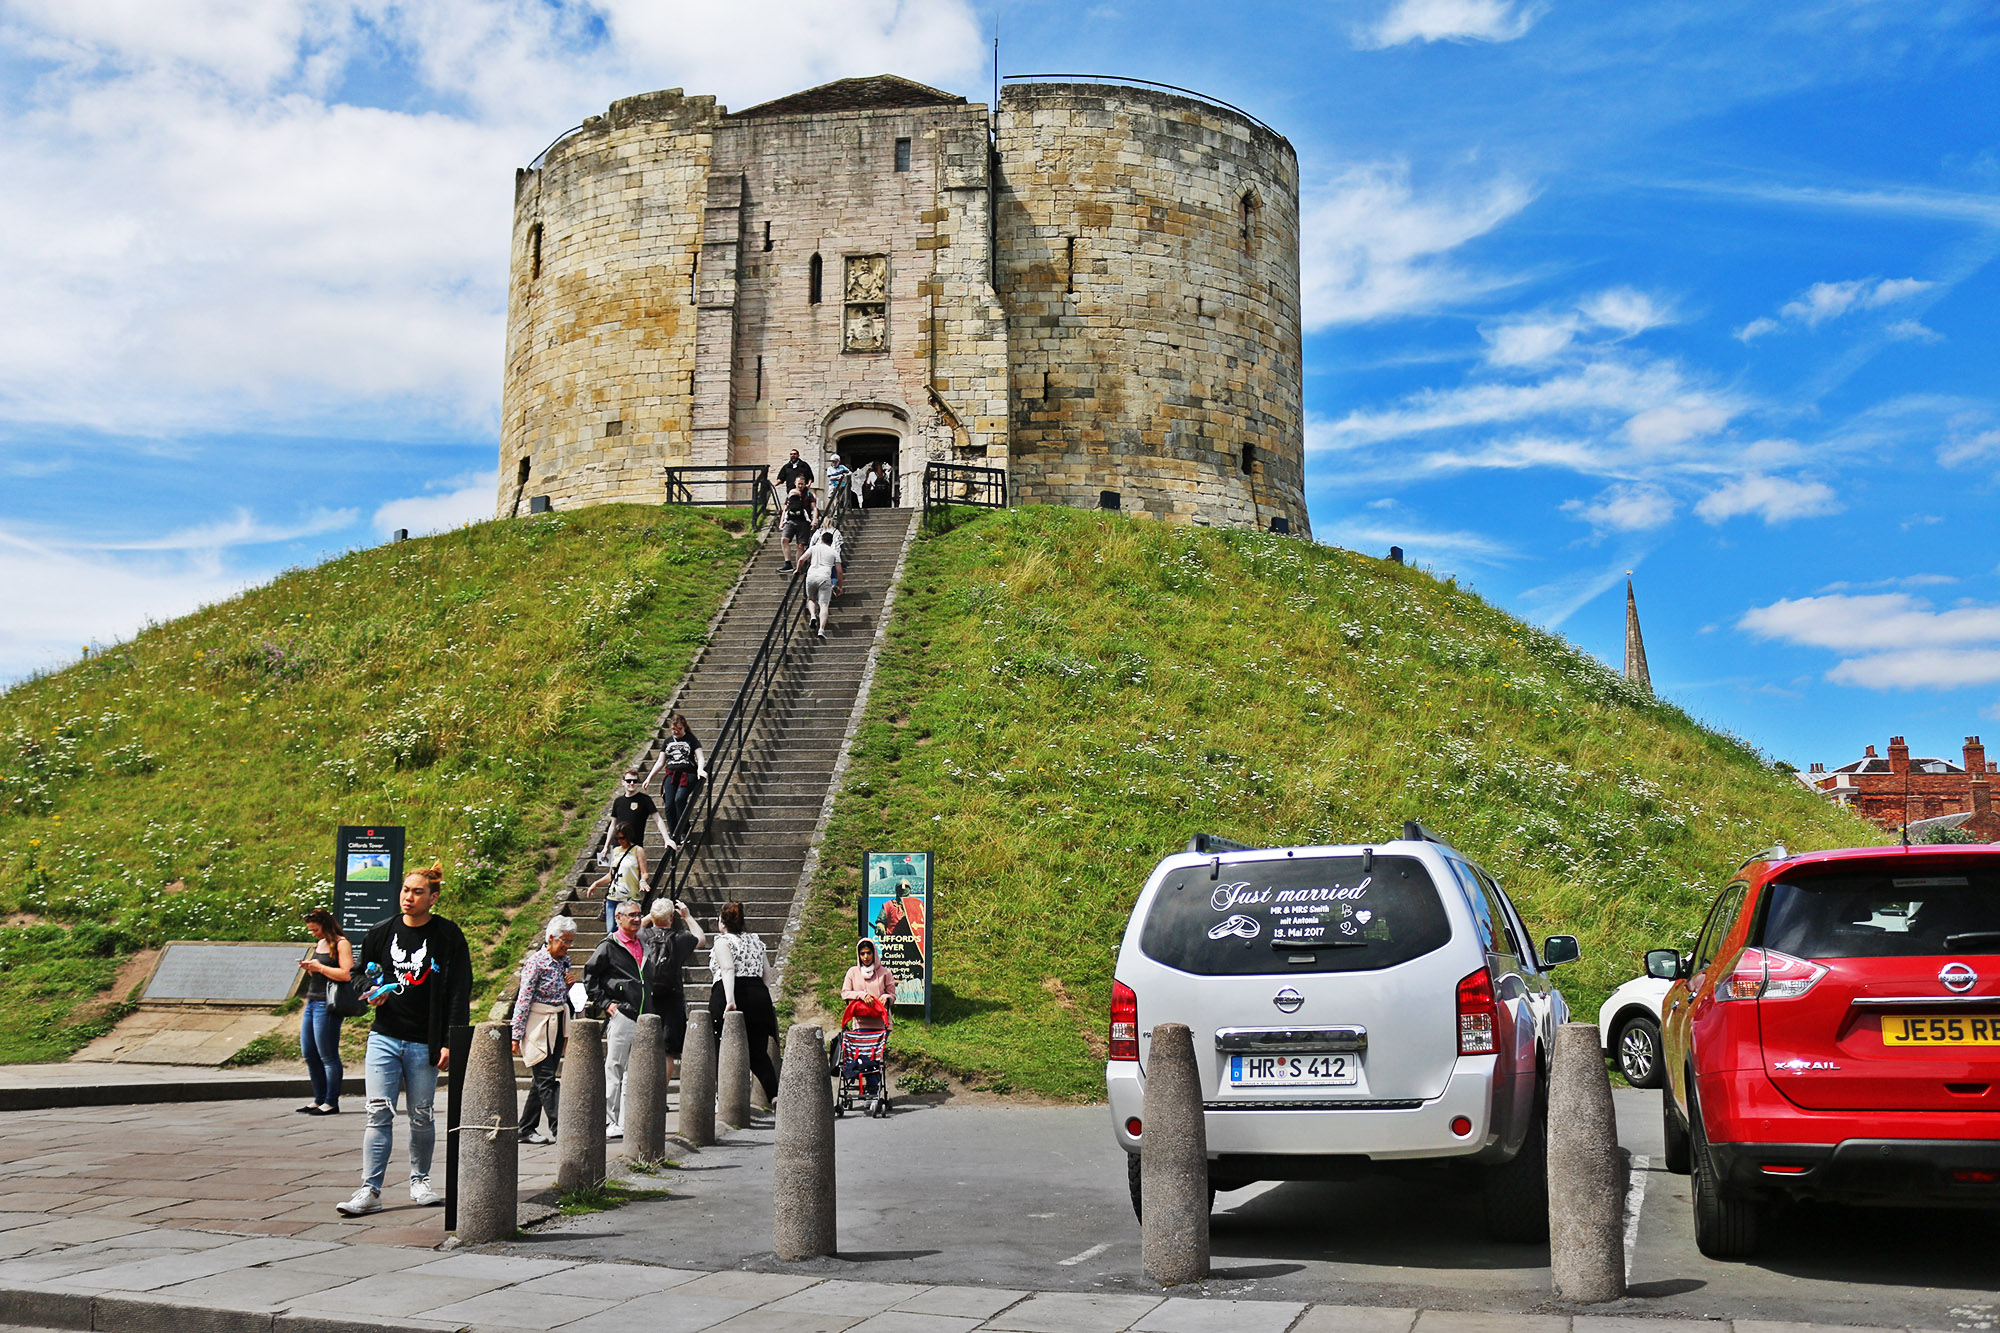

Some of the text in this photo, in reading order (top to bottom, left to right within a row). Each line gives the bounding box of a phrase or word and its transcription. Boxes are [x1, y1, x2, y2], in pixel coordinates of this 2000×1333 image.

[1210, 876, 1373, 912] Just married
[1270, 904, 1330, 915] MR & MRS Smith
[1280, 916, 1319, 925] mit Antonia
[1288, 927, 1303, 937] Mai
[1303, 927, 1326, 937] 2017
[872, 935, 922, 943] CLIFFORD'S
[891, 959, 921, 967] stronghold
[1940, 974, 1974, 982] NISSAN
[1895, 1019, 1964, 1041] JE55
[1249, 1058, 1275, 1078] HR
[1289, 1058, 1302, 1078] S
[1307, 1057, 1346, 1078] 412
